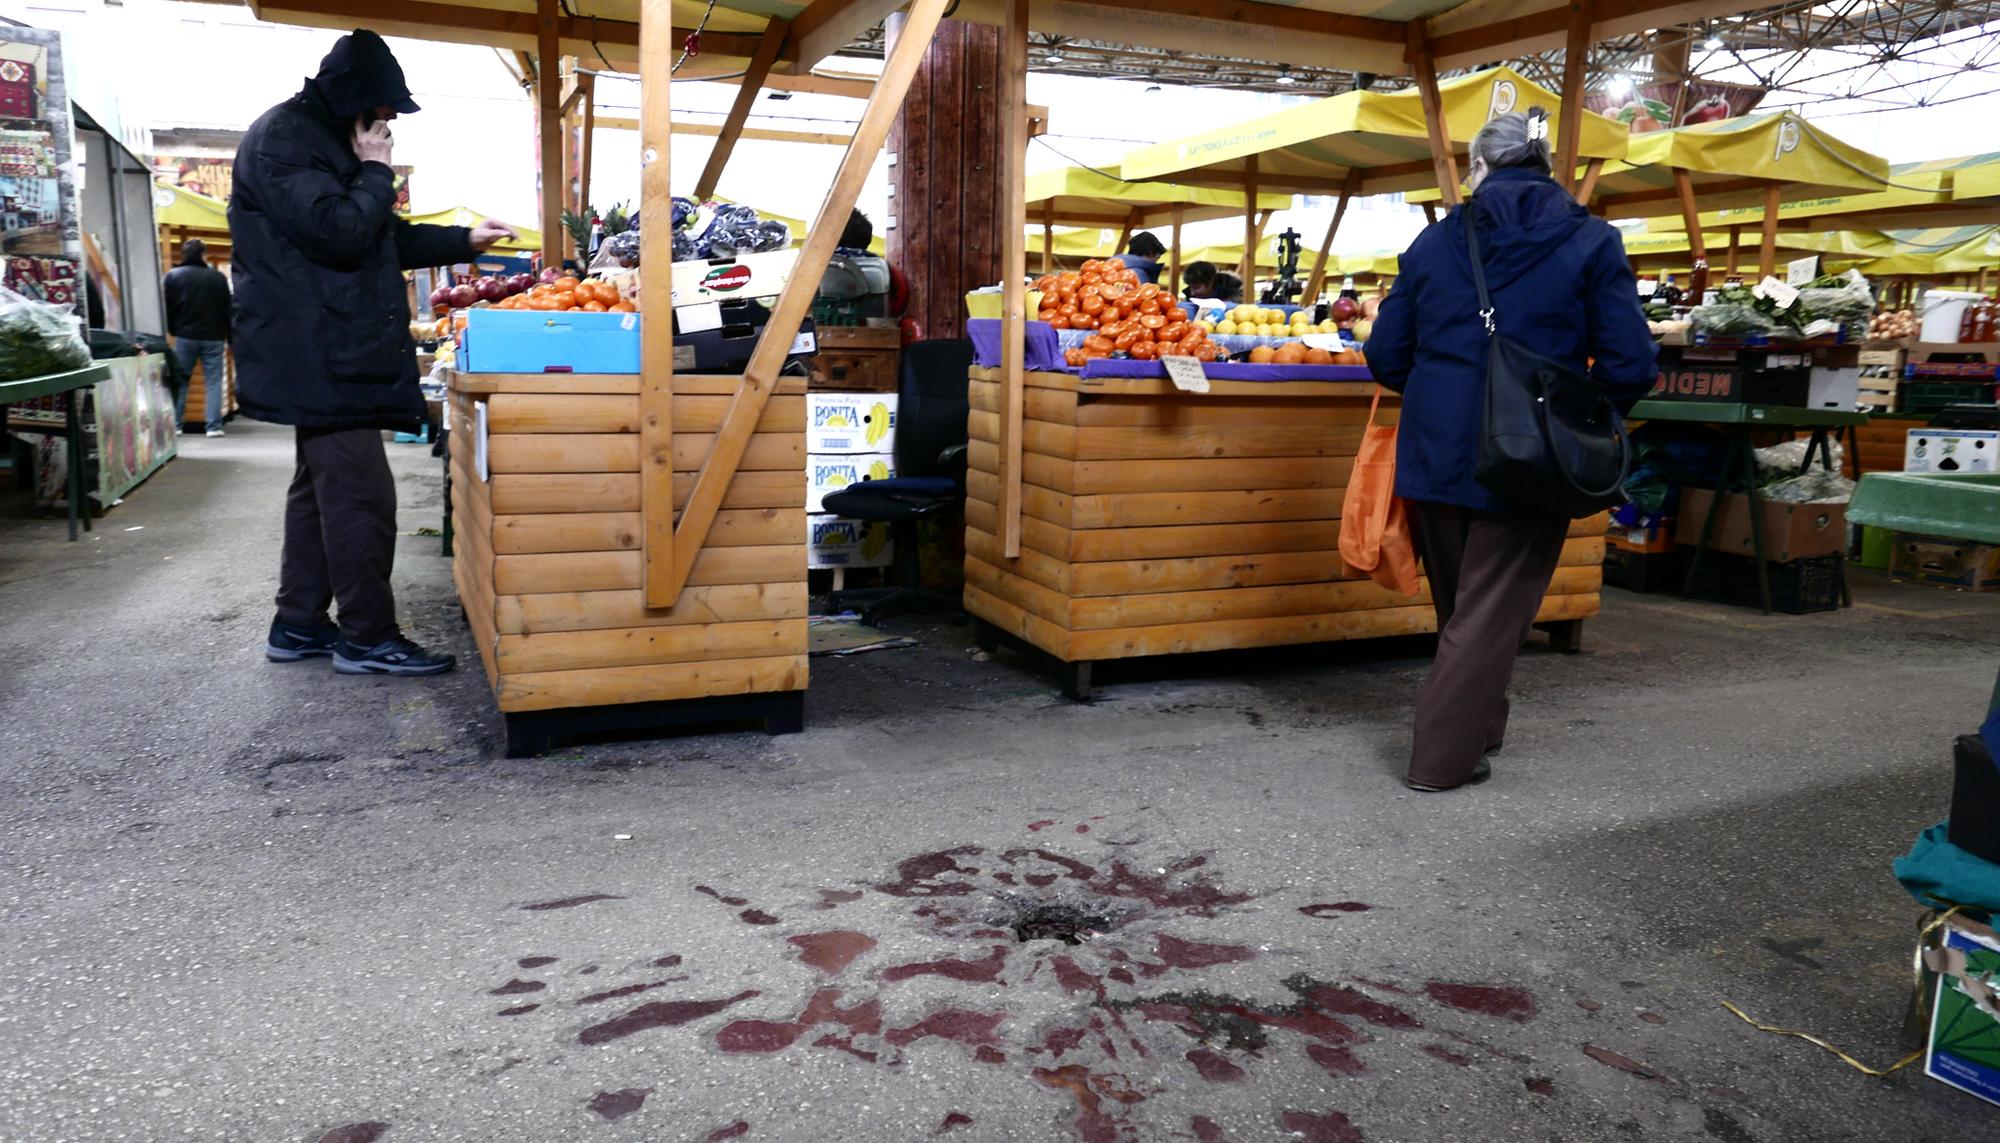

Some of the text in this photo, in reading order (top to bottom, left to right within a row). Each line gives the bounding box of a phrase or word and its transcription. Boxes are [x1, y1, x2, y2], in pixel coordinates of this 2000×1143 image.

[815, 405, 859, 428] BONITA
[815, 465, 858, 486] BONITA
[813, 522, 857, 544] BONITA
